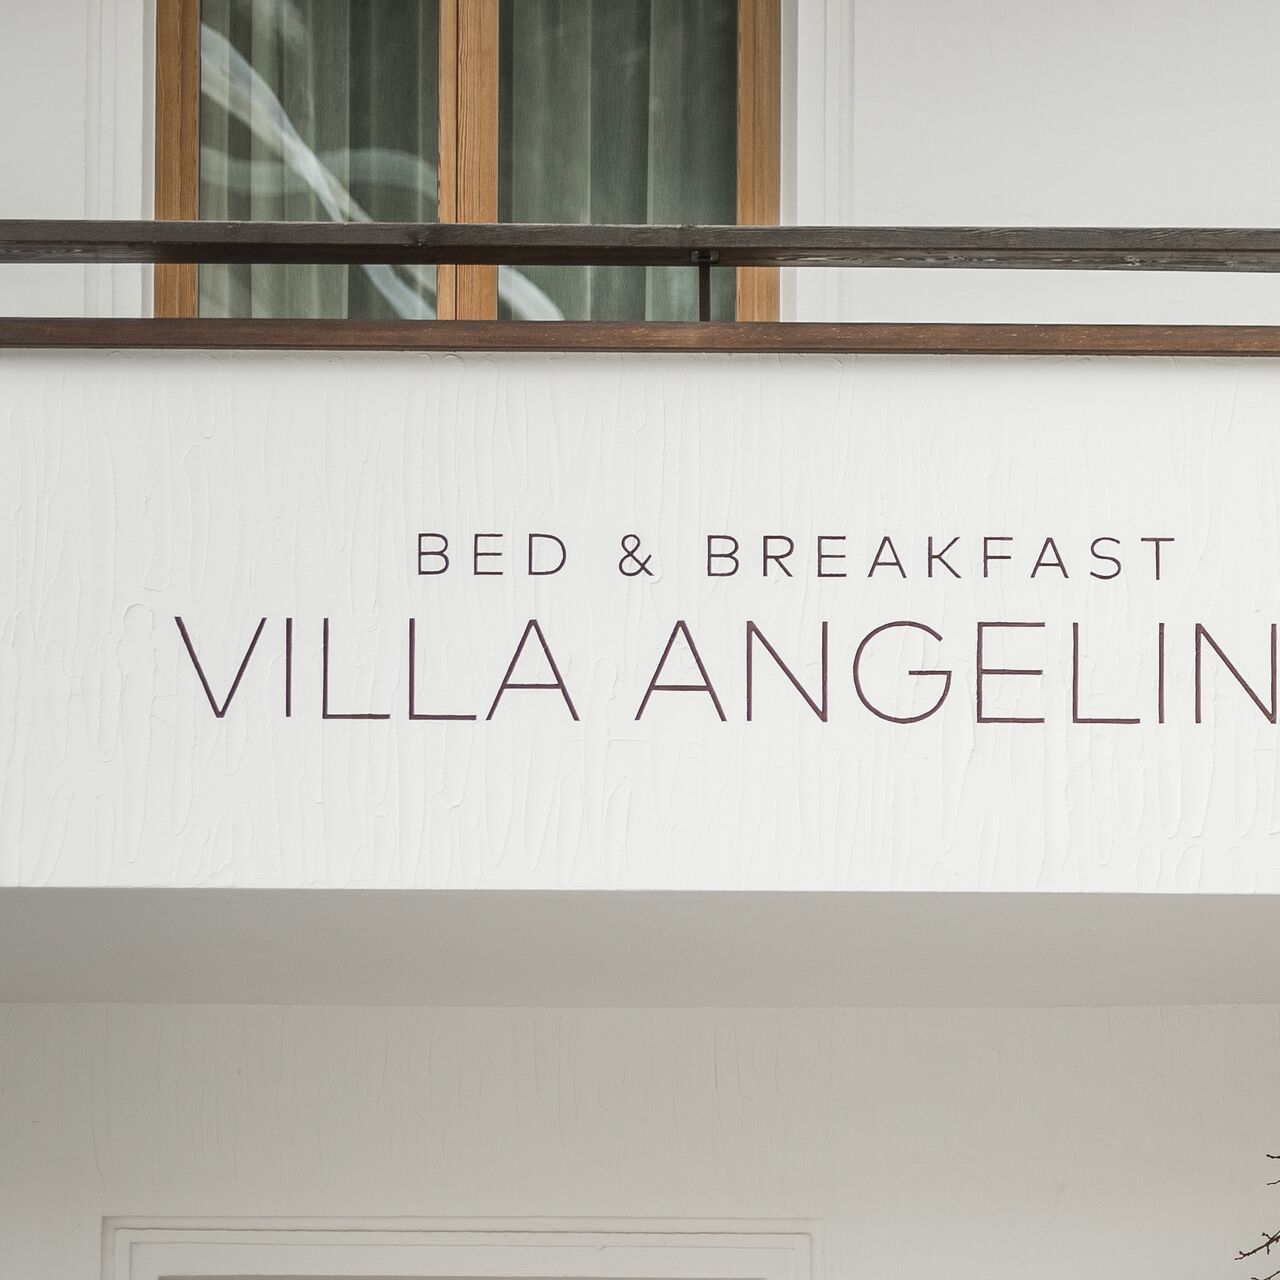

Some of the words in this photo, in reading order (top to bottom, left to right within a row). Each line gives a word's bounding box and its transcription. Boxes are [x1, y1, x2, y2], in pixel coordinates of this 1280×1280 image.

[417, 532, 567, 576] BED
[618, 533, 655, 577] &
[706, 534, 1175, 581] BREAKFAST
[174, 616, 580, 722] VILLA
